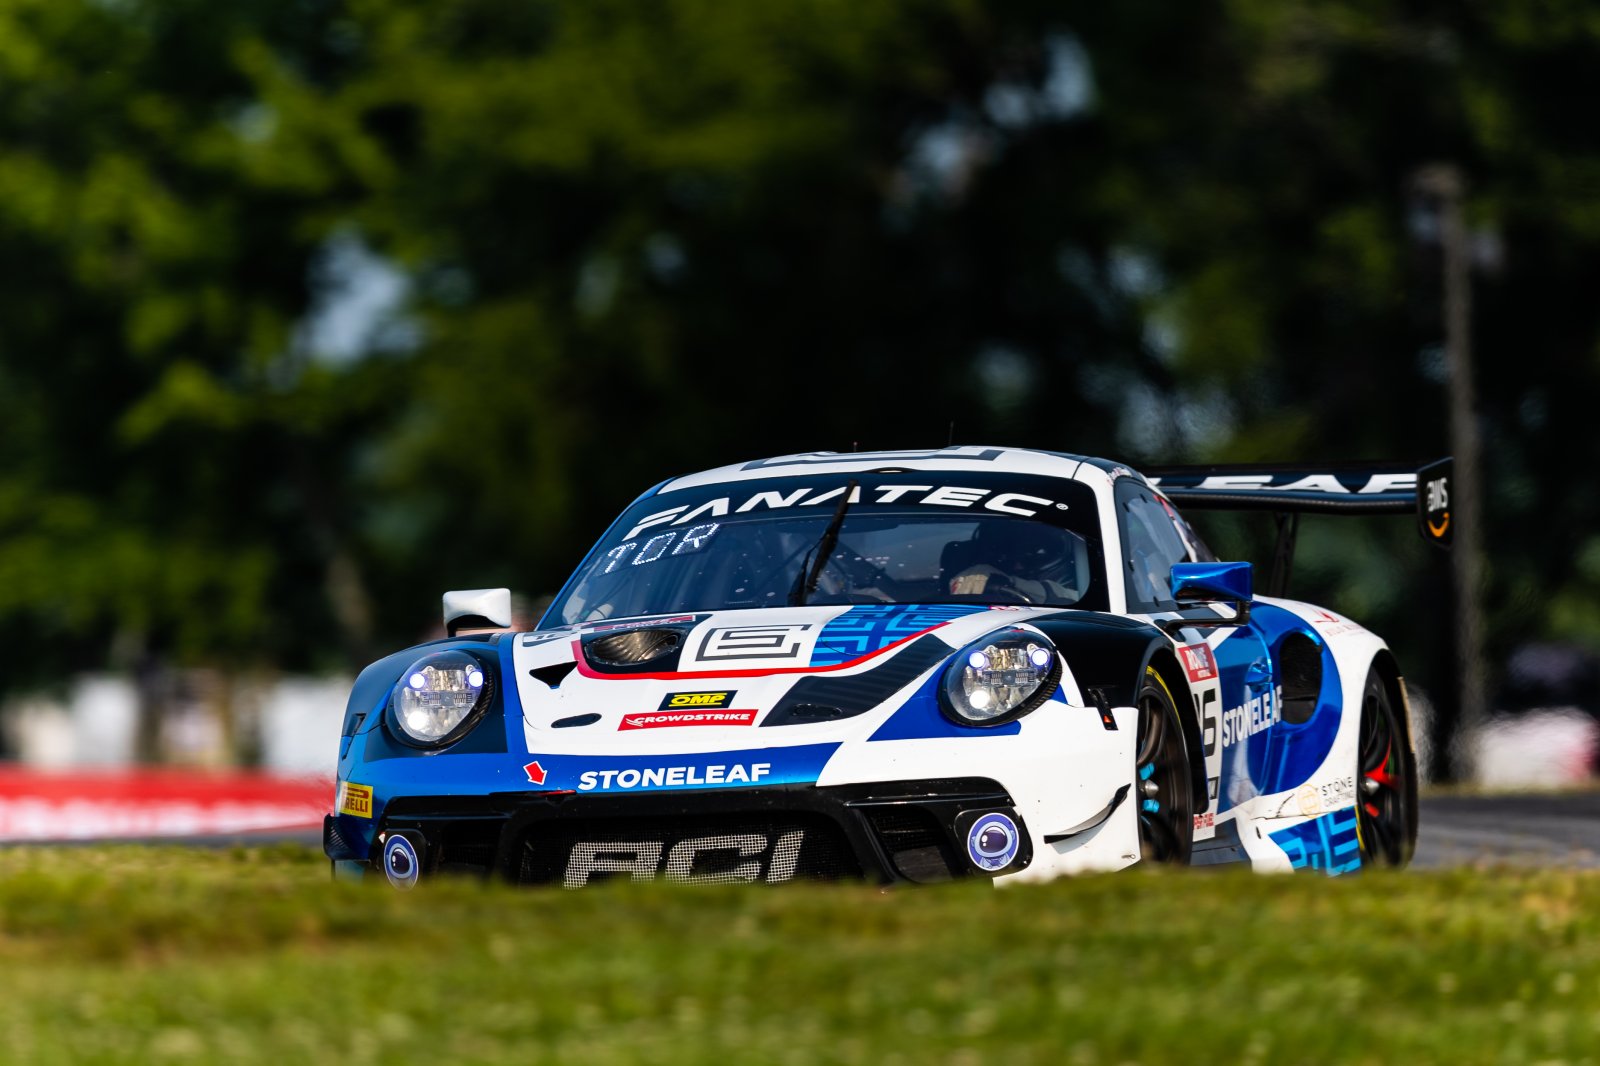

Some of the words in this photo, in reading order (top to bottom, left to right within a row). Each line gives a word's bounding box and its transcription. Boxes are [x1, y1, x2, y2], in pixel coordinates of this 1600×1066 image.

[1149, 474, 1418, 494] EAF
[622, 485, 1054, 541] FANATEC
[671, 695, 725, 704] OMP
[632, 713, 750, 725] CROWDSTRIKE
[1223, 685, 1283, 748] STONELEAF
[577, 762, 771, 791] STONELEAF
